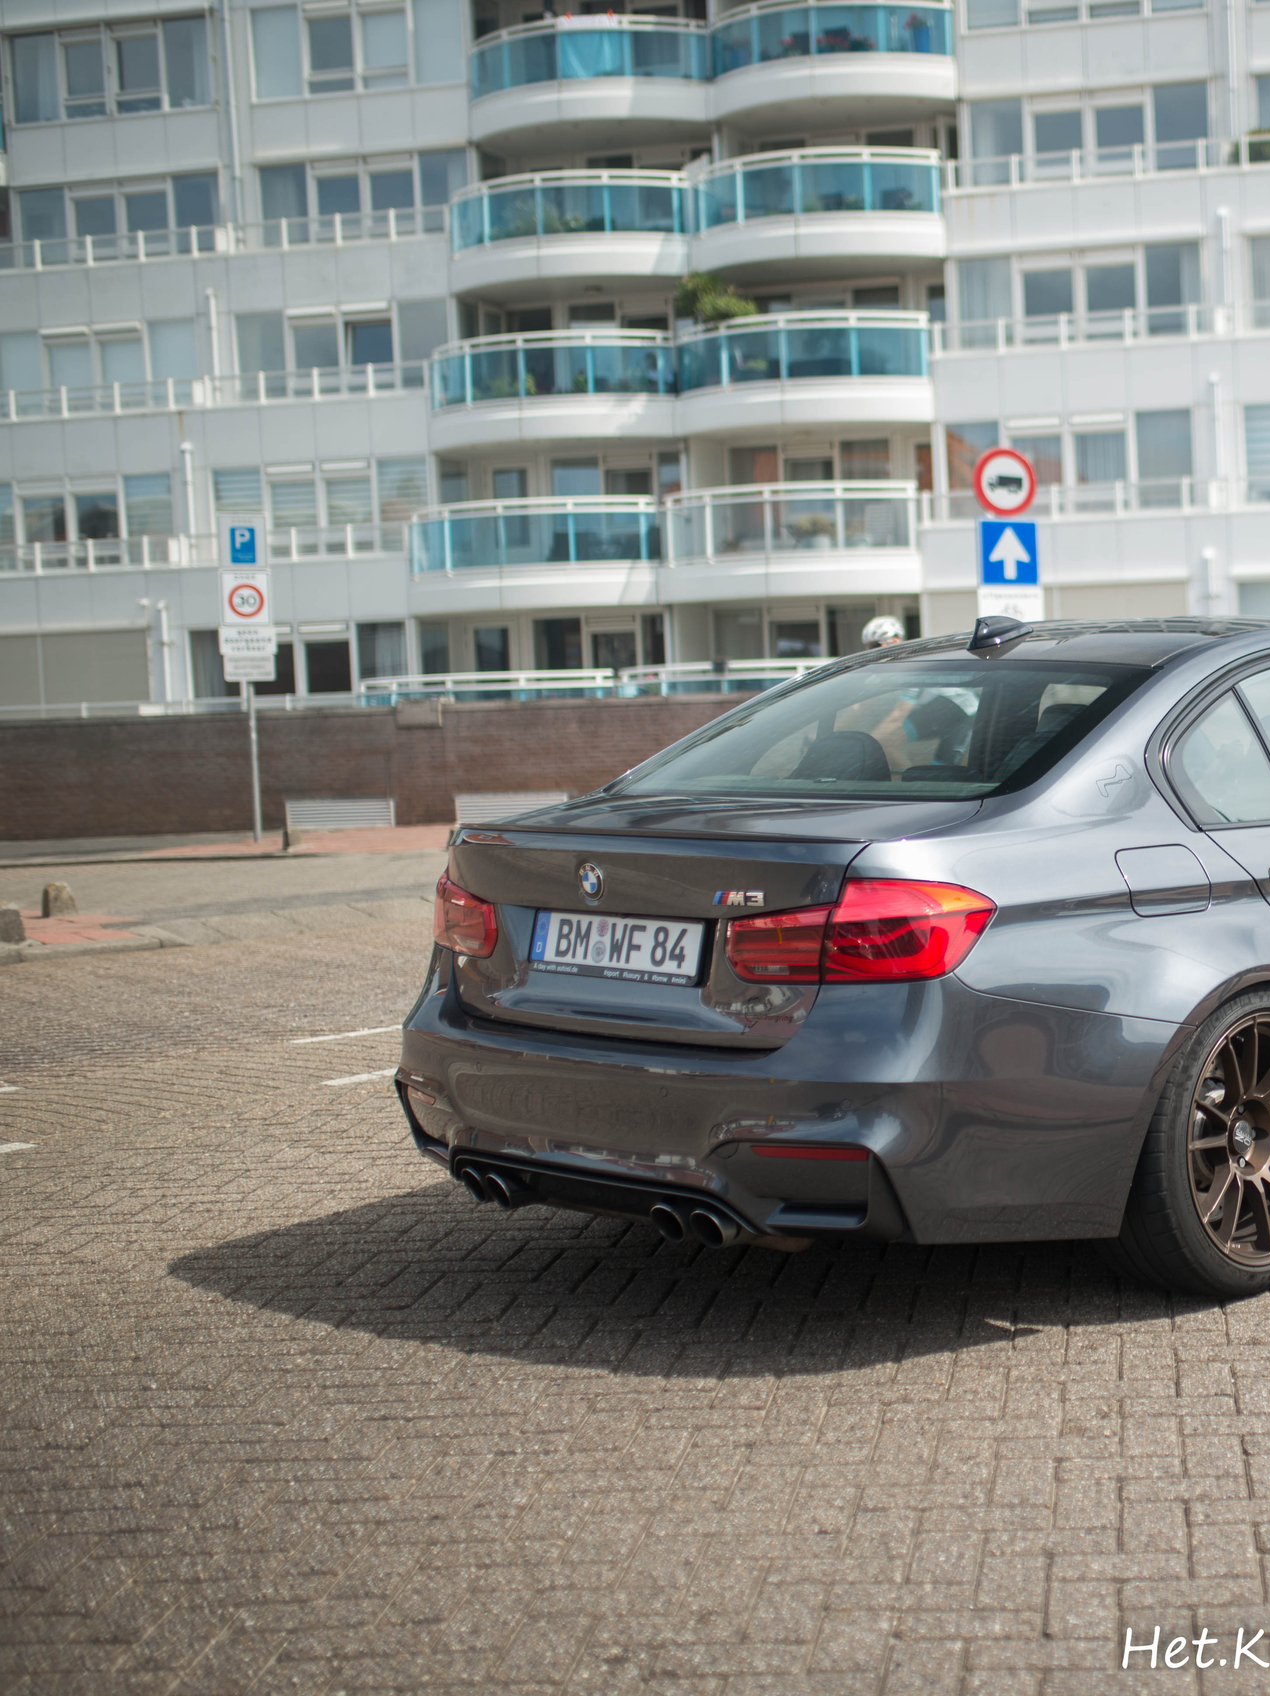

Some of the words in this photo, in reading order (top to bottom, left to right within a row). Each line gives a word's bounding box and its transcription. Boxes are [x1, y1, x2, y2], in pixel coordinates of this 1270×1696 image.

[234, 528, 250, 549] P
[235, 593, 257, 608] 30
[724, 891, 765, 906] M3
[535, 941, 542, 953] D
[554, 918, 593, 960] BM
[608, 922, 647, 964] WF
[650, 926, 688, 969] 84
